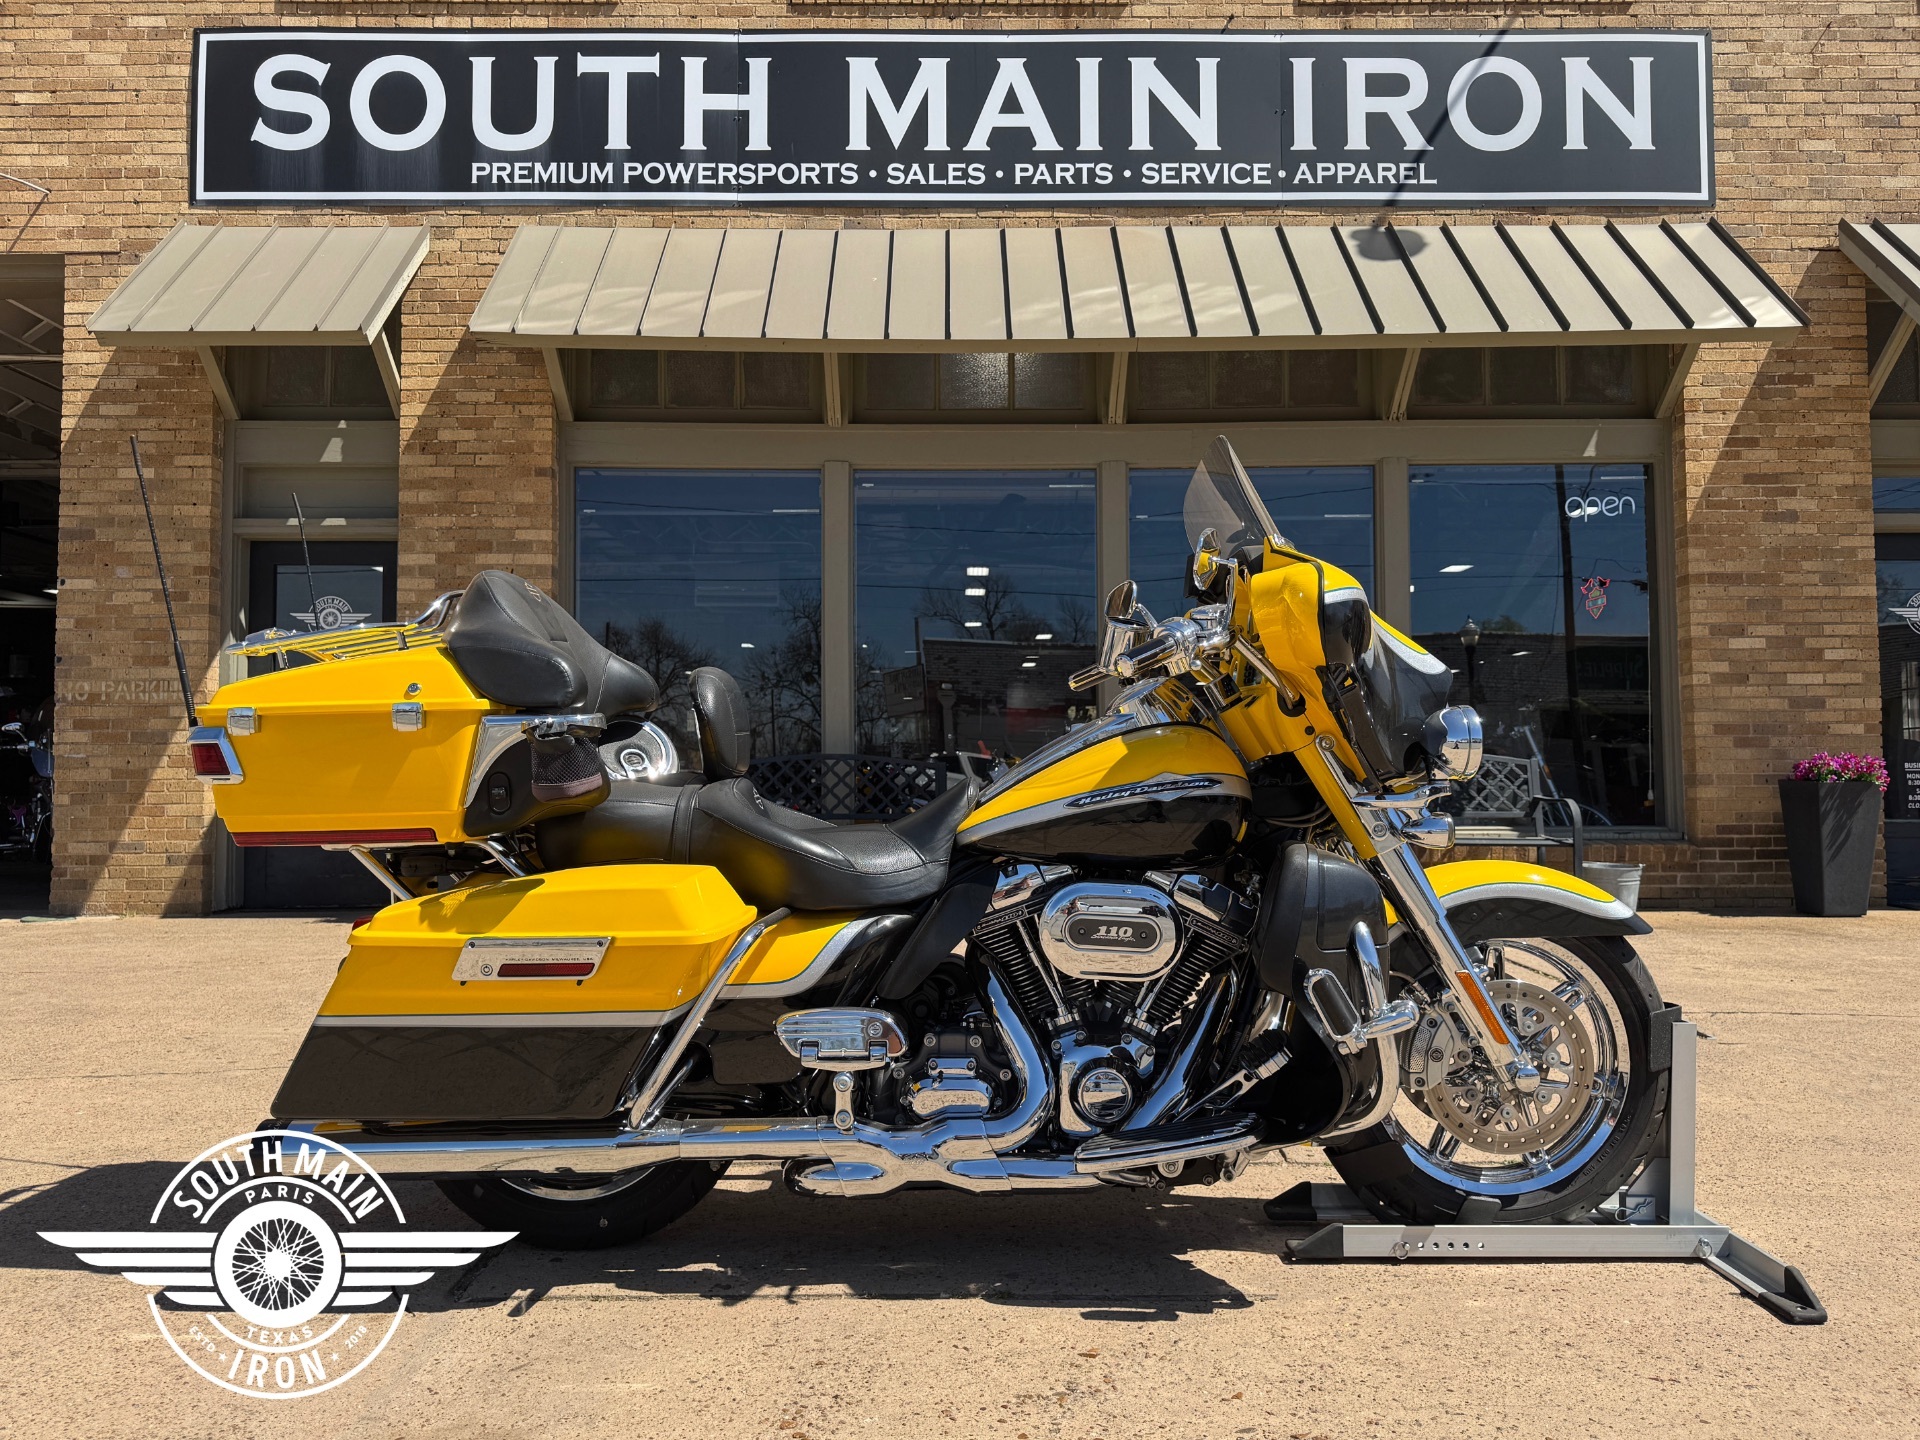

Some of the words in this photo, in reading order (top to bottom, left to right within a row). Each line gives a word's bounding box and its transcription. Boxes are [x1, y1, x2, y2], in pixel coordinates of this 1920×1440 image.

[250, 52, 772, 151] SOUTH
[846, 57, 1221, 151] MAIN
[1290, 56, 1655, 151] IRON
[471, 162, 614, 184] PREMIUM
[623, 162, 859, 185] POWERSPORTS
[886, 162, 986, 185] SALES
[1014, 162, 1114, 185] PARTS
[1141, 162, 1272, 185] SERVICE
[1293, 162, 1438, 185] APPAREL
[1565, 496, 1635, 522] open
[57, 680, 91, 701] NO
[1076, 781, 1213, 805] Harley-Davidson
[1097, 926, 1133, 938] 110
